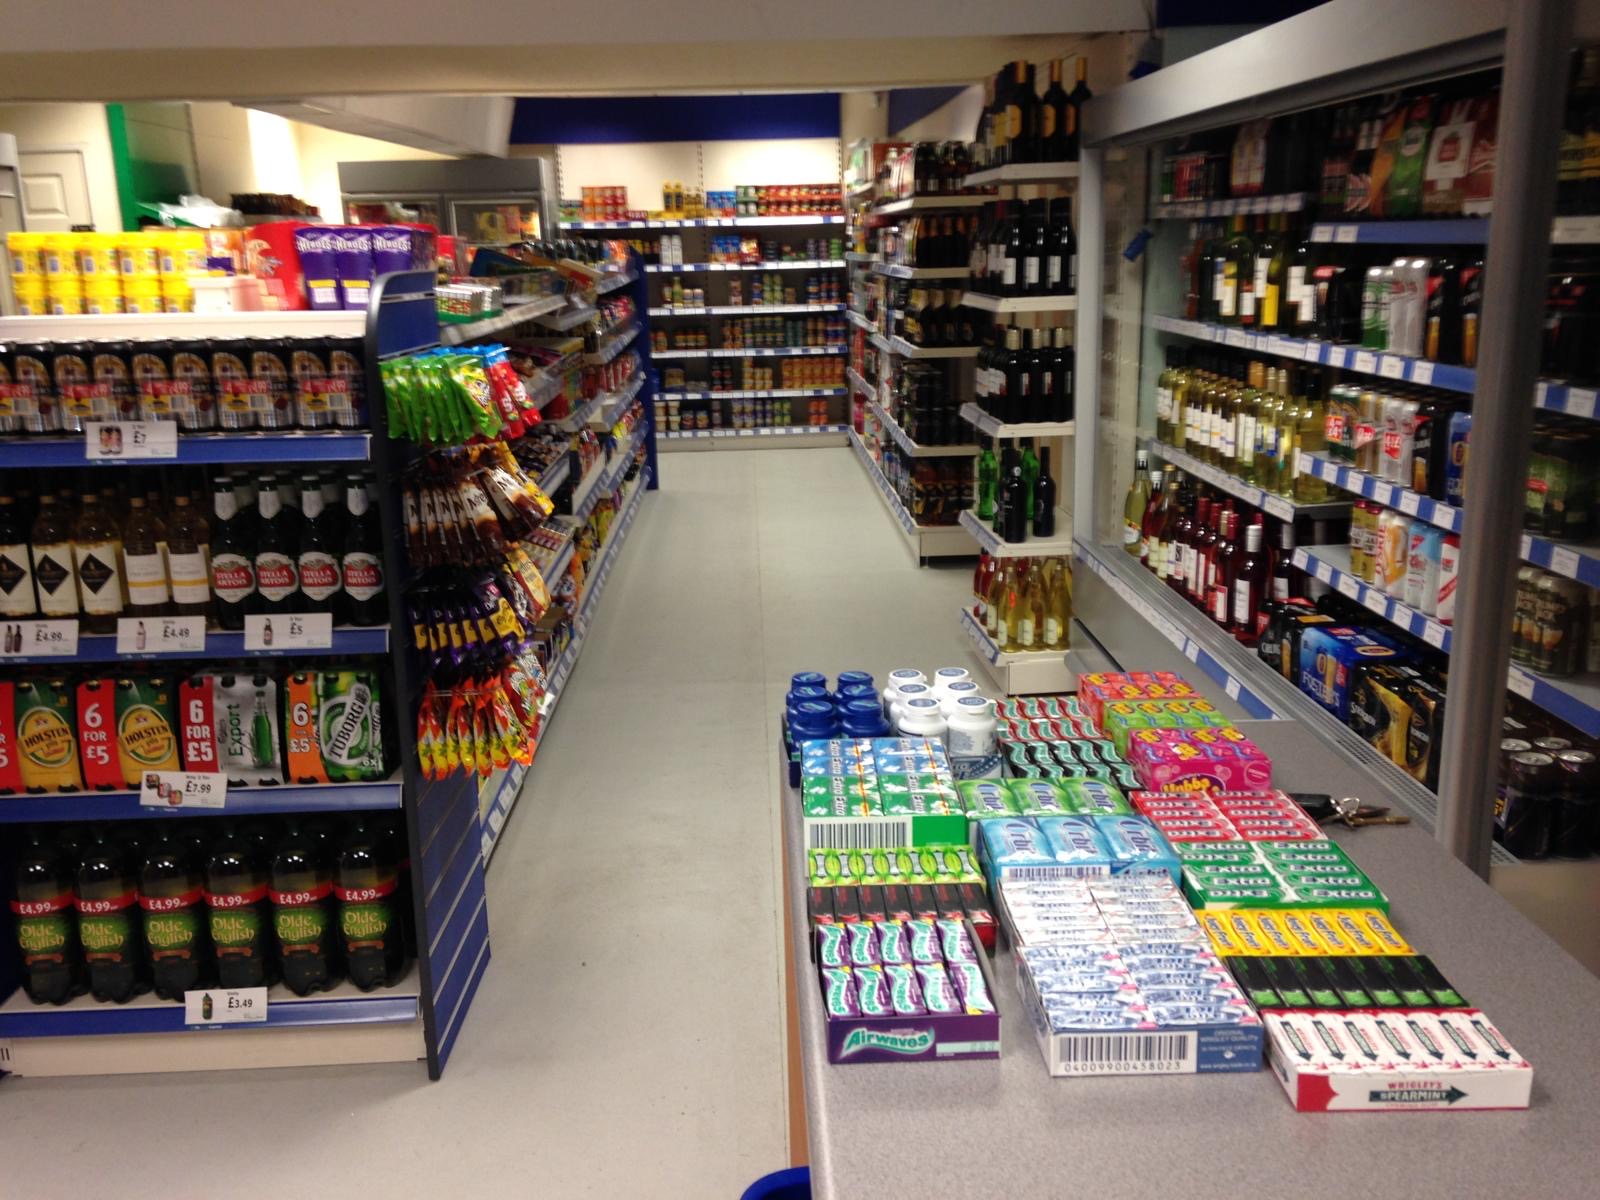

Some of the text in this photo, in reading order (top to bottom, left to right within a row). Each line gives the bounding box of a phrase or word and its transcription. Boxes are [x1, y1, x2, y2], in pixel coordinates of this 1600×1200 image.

[216, 571, 246, 579] STELLA
[260, 571, 288, 579] STELLA
[303, 570, 331, 578] STELLA
[347, 570, 375, 578] STELLA
[217, 579, 248, 587] ARTOIS
[260, 578, 289, 586] ARTOIS
[304, 577, 333, 585] ARTOIS
[348, 577, 377, 585] ARTOIS
[85, 703, 103, 728] 6
[189, 699, 204, 724] 6
[293, 703, 309, 727] 6
[125, 725, 169, 745] HOLSTEN
[186, 725, 211, 739] FOR
[228, 703, 244, 757] Export
[329, 700, 363, 758] TUBORG
[24, 727, 70, 748] HOLSTEN
[83, 731, 108, 743] FOR
[187, 742, 214, 762] £5
[289, 738, 311, 753] £5
[86, 746, 110, 765] £5
[186, 781, 212, 794] £7.99
[1192, 842, 1247, 850] Extra
[1274, 841, 1329, 850] Extra
[1281, 853, 1338, 862] Extra
[1206, 865, 1263, 873] Extra
[1290, 864, 1348, 873] Extra
[1213, 877, 1271, 886] Extra
[1301, 876, 1361, 885] Extra
[280, 892, 311, 905] £4.99
[346, 889, 376, 902] £4.99
[1313, 888, 1375, 898] Extra
[80, 901, 111, 913] £4.99
[149, 897, 181, 911] £4.99
[212, 896, 242, 907] £4.99
[20, 903, 51, 915] £4.99
[213, 917, 245, 930] Olde
[279, 914, 312, 927] Olde
[345, 911, 379, 924] Olde
[21, 924, 55, 937] Olde
[81, 922, 113, 936] Olde
[149, 920, 183, 933] Olde
[343, 922, 387, 938] English
[147, 931, 193, 947] English
[211, 928, 255, 945] English
[277, 926, 322, 942] English
[18, 935, 65, 952] English
[80, 934, 124, 949] English
[228, 996, 253, 1009] £3.49
[846, 1031, 929, 1051] Airwaves
[1388, 1081, 1443, 1089] WRIGLEY'S
[1380, 1091, 1447, 1101] SPEARMINT
